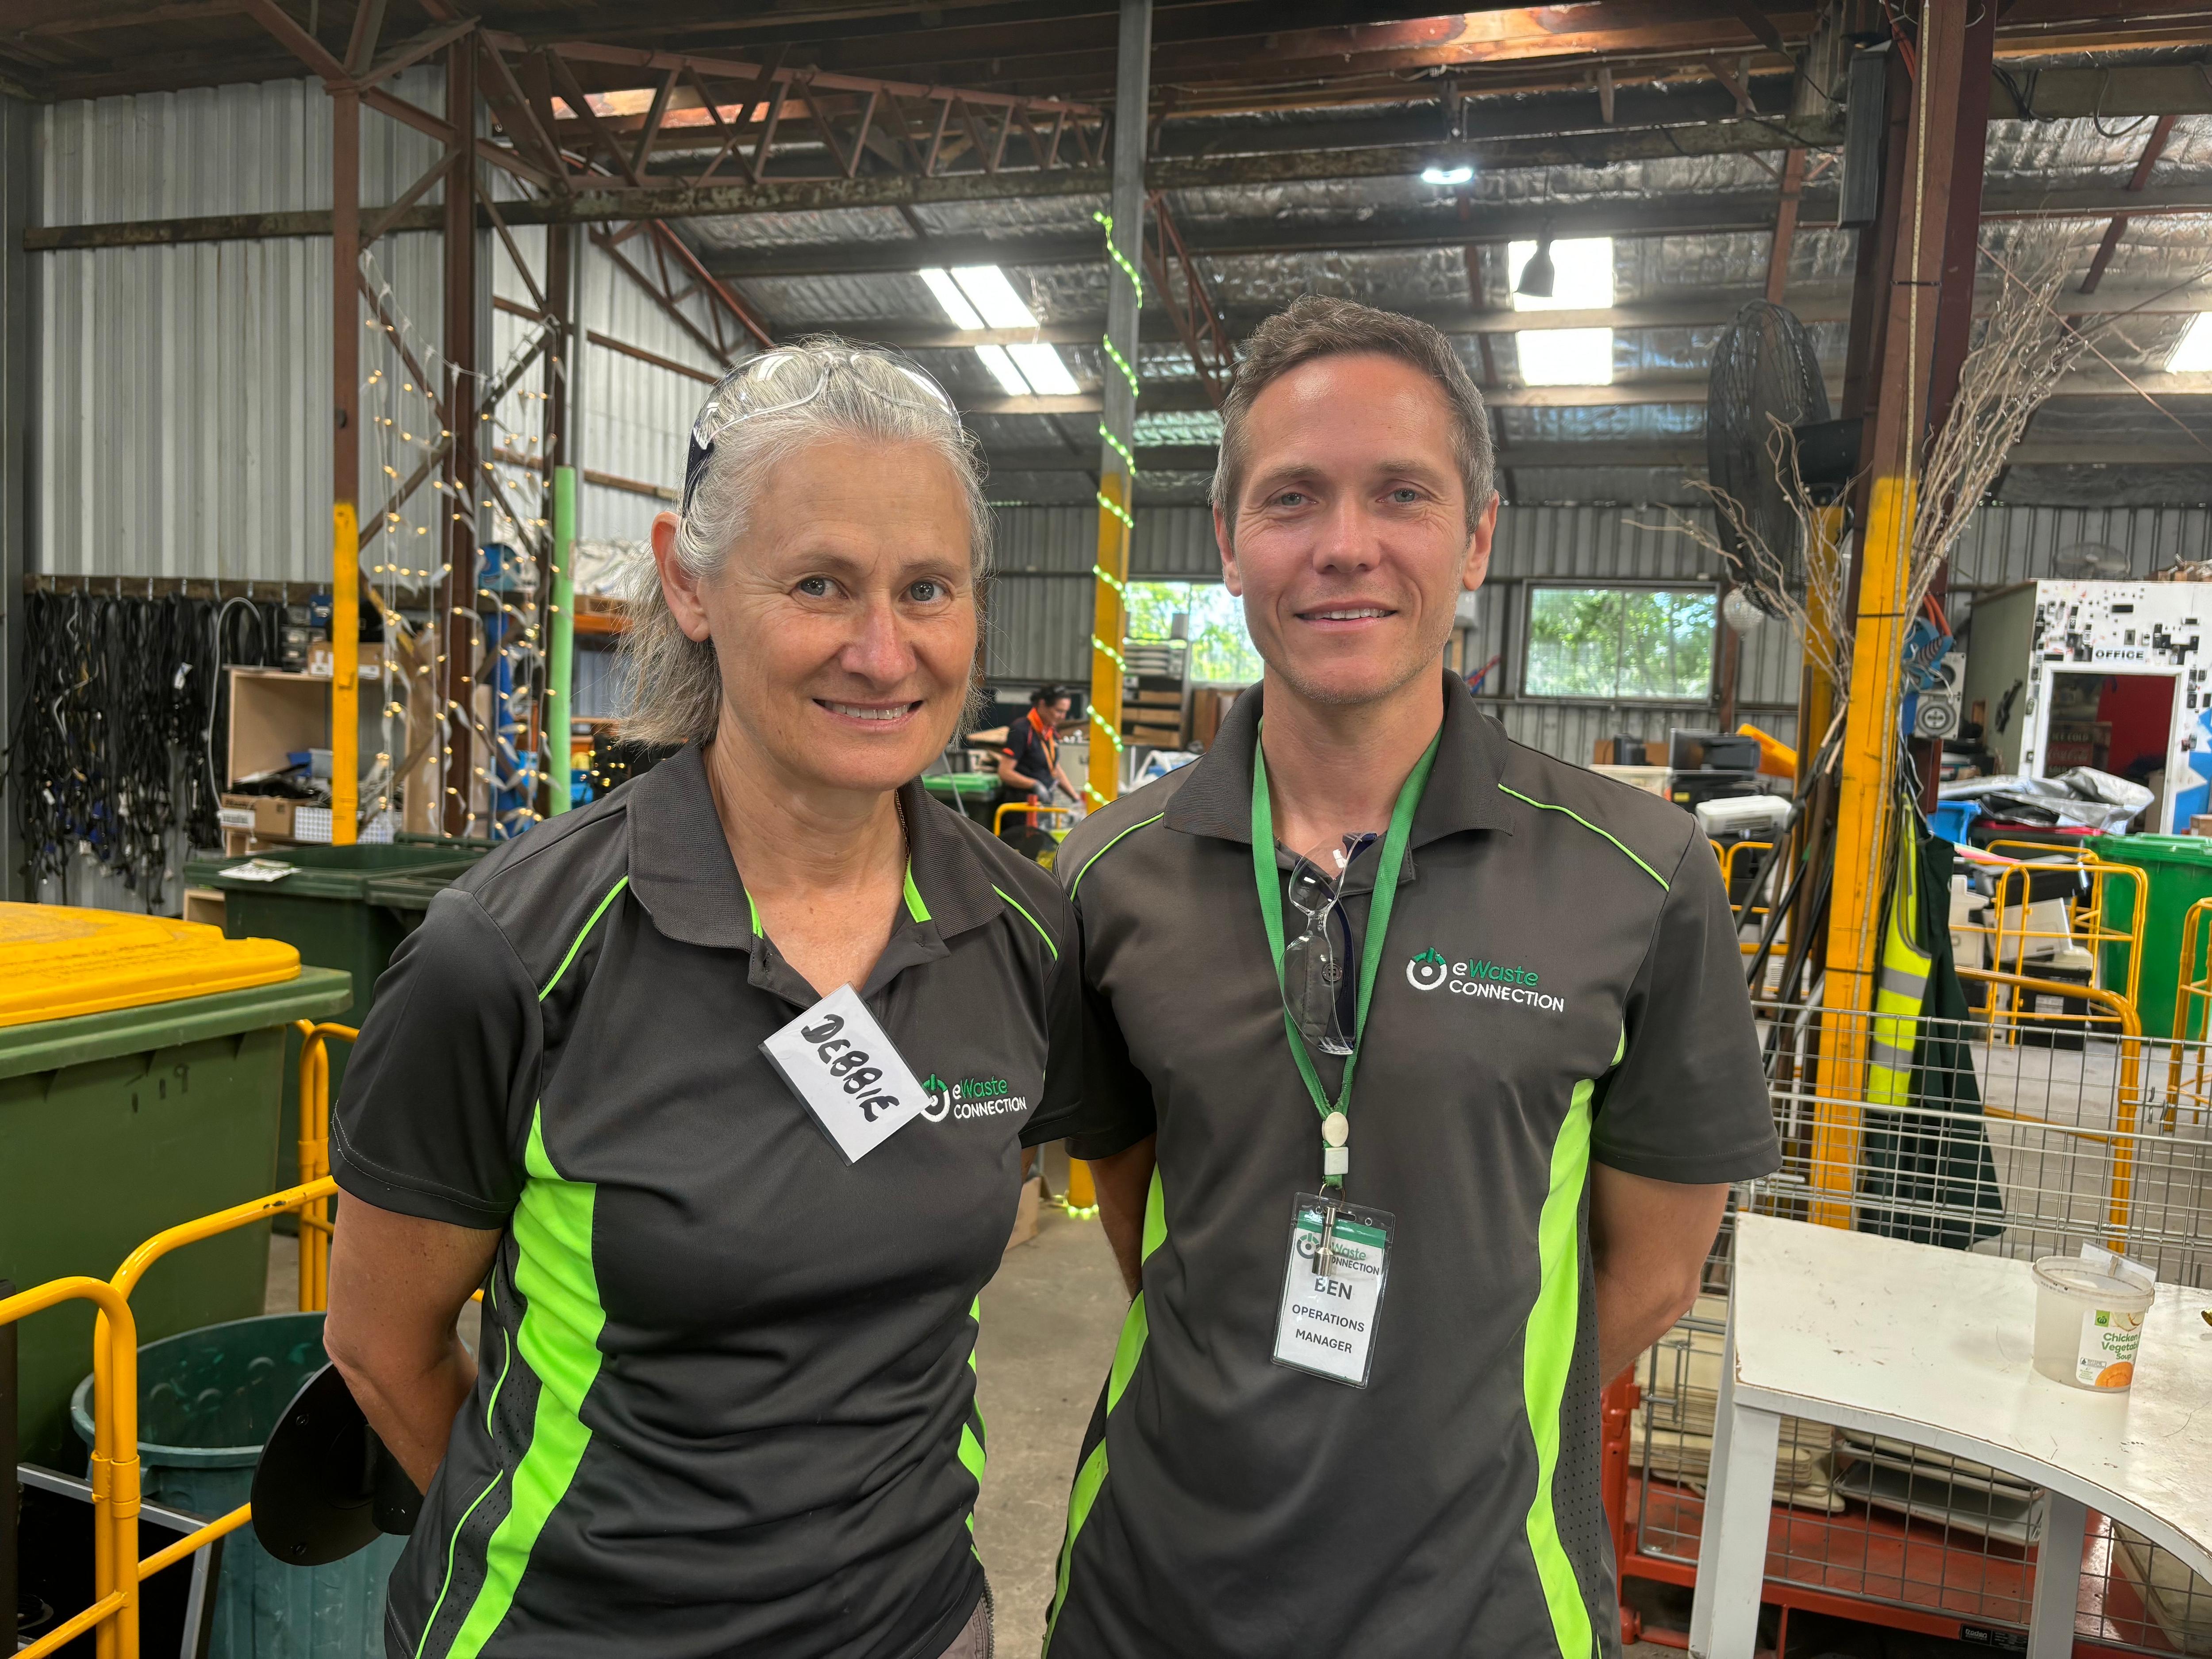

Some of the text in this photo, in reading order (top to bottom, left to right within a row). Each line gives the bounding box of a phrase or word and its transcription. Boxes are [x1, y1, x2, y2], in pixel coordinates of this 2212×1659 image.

[2096, 650, 2144, 660] OFFICE
[1452, 959, 1539, 986] eWaste
[1449, 980, 1564, 1012] CONNECTION
[801, 1014, 900, 1122] DEBBIE
[952, 1075, 1007, 1098] eWaste
[954, 1097, 1027, 1119] CONNECTION
[1331, 1242, 1366, 1260] Waste
[1314, 1277, 1352, 1300] BEN
[1292, 1304, 1364, 1332] OPERATIONS
[1295, 1329, 1352, 1353] MANAGER
[2103, 1333, 2138, 1342] Chicken
